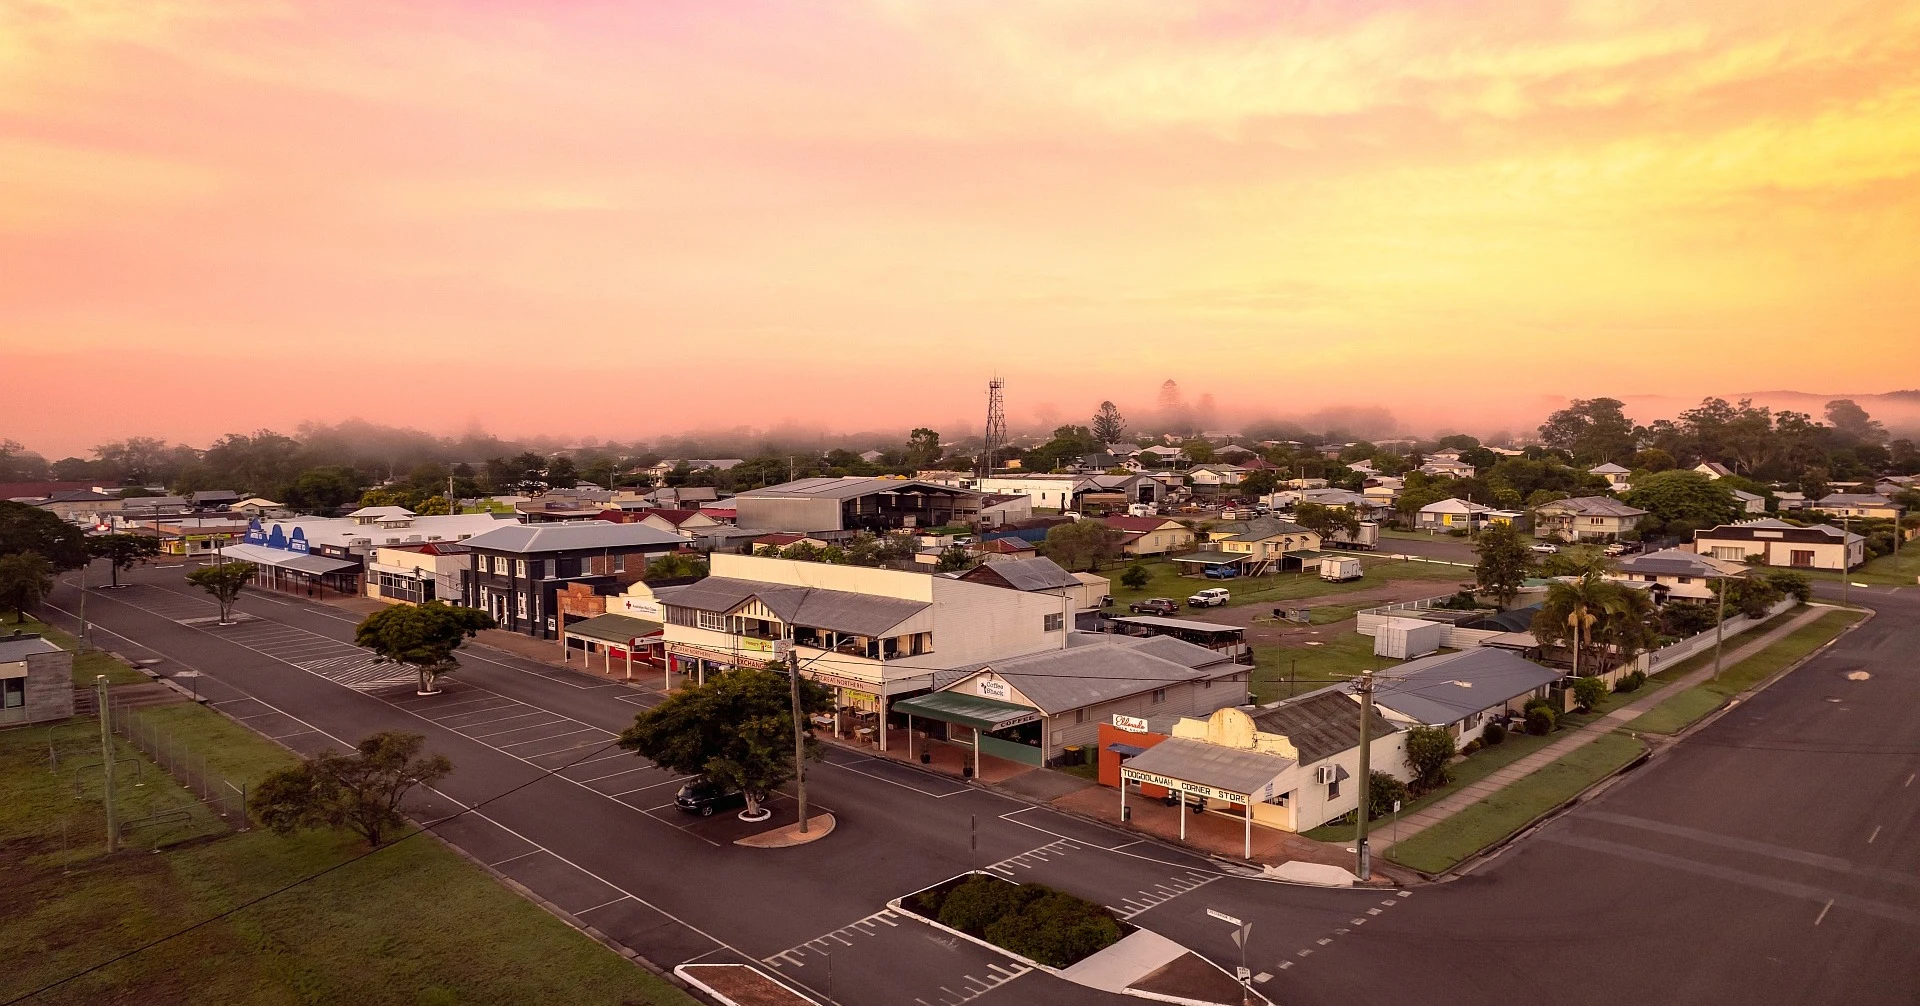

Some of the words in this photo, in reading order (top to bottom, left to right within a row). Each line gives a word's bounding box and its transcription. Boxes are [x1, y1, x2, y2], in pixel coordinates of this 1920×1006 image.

[738, 658, 769, 669] EXCHANG
[820, 675, 836, 684] GREAT
[837, 679, 864, 690] NORTHERN
[986, 681, 1004, 690] Coffee
[986, 688, 1004, 697] Shack
[1000, 715, 1035, 727] COFFEE
[1122, 768, 1174, 787] TOOGOOLAWAH
[1181, 782, 1211, 796] CORNER
[1218, 790, 1247, 804] STORE
